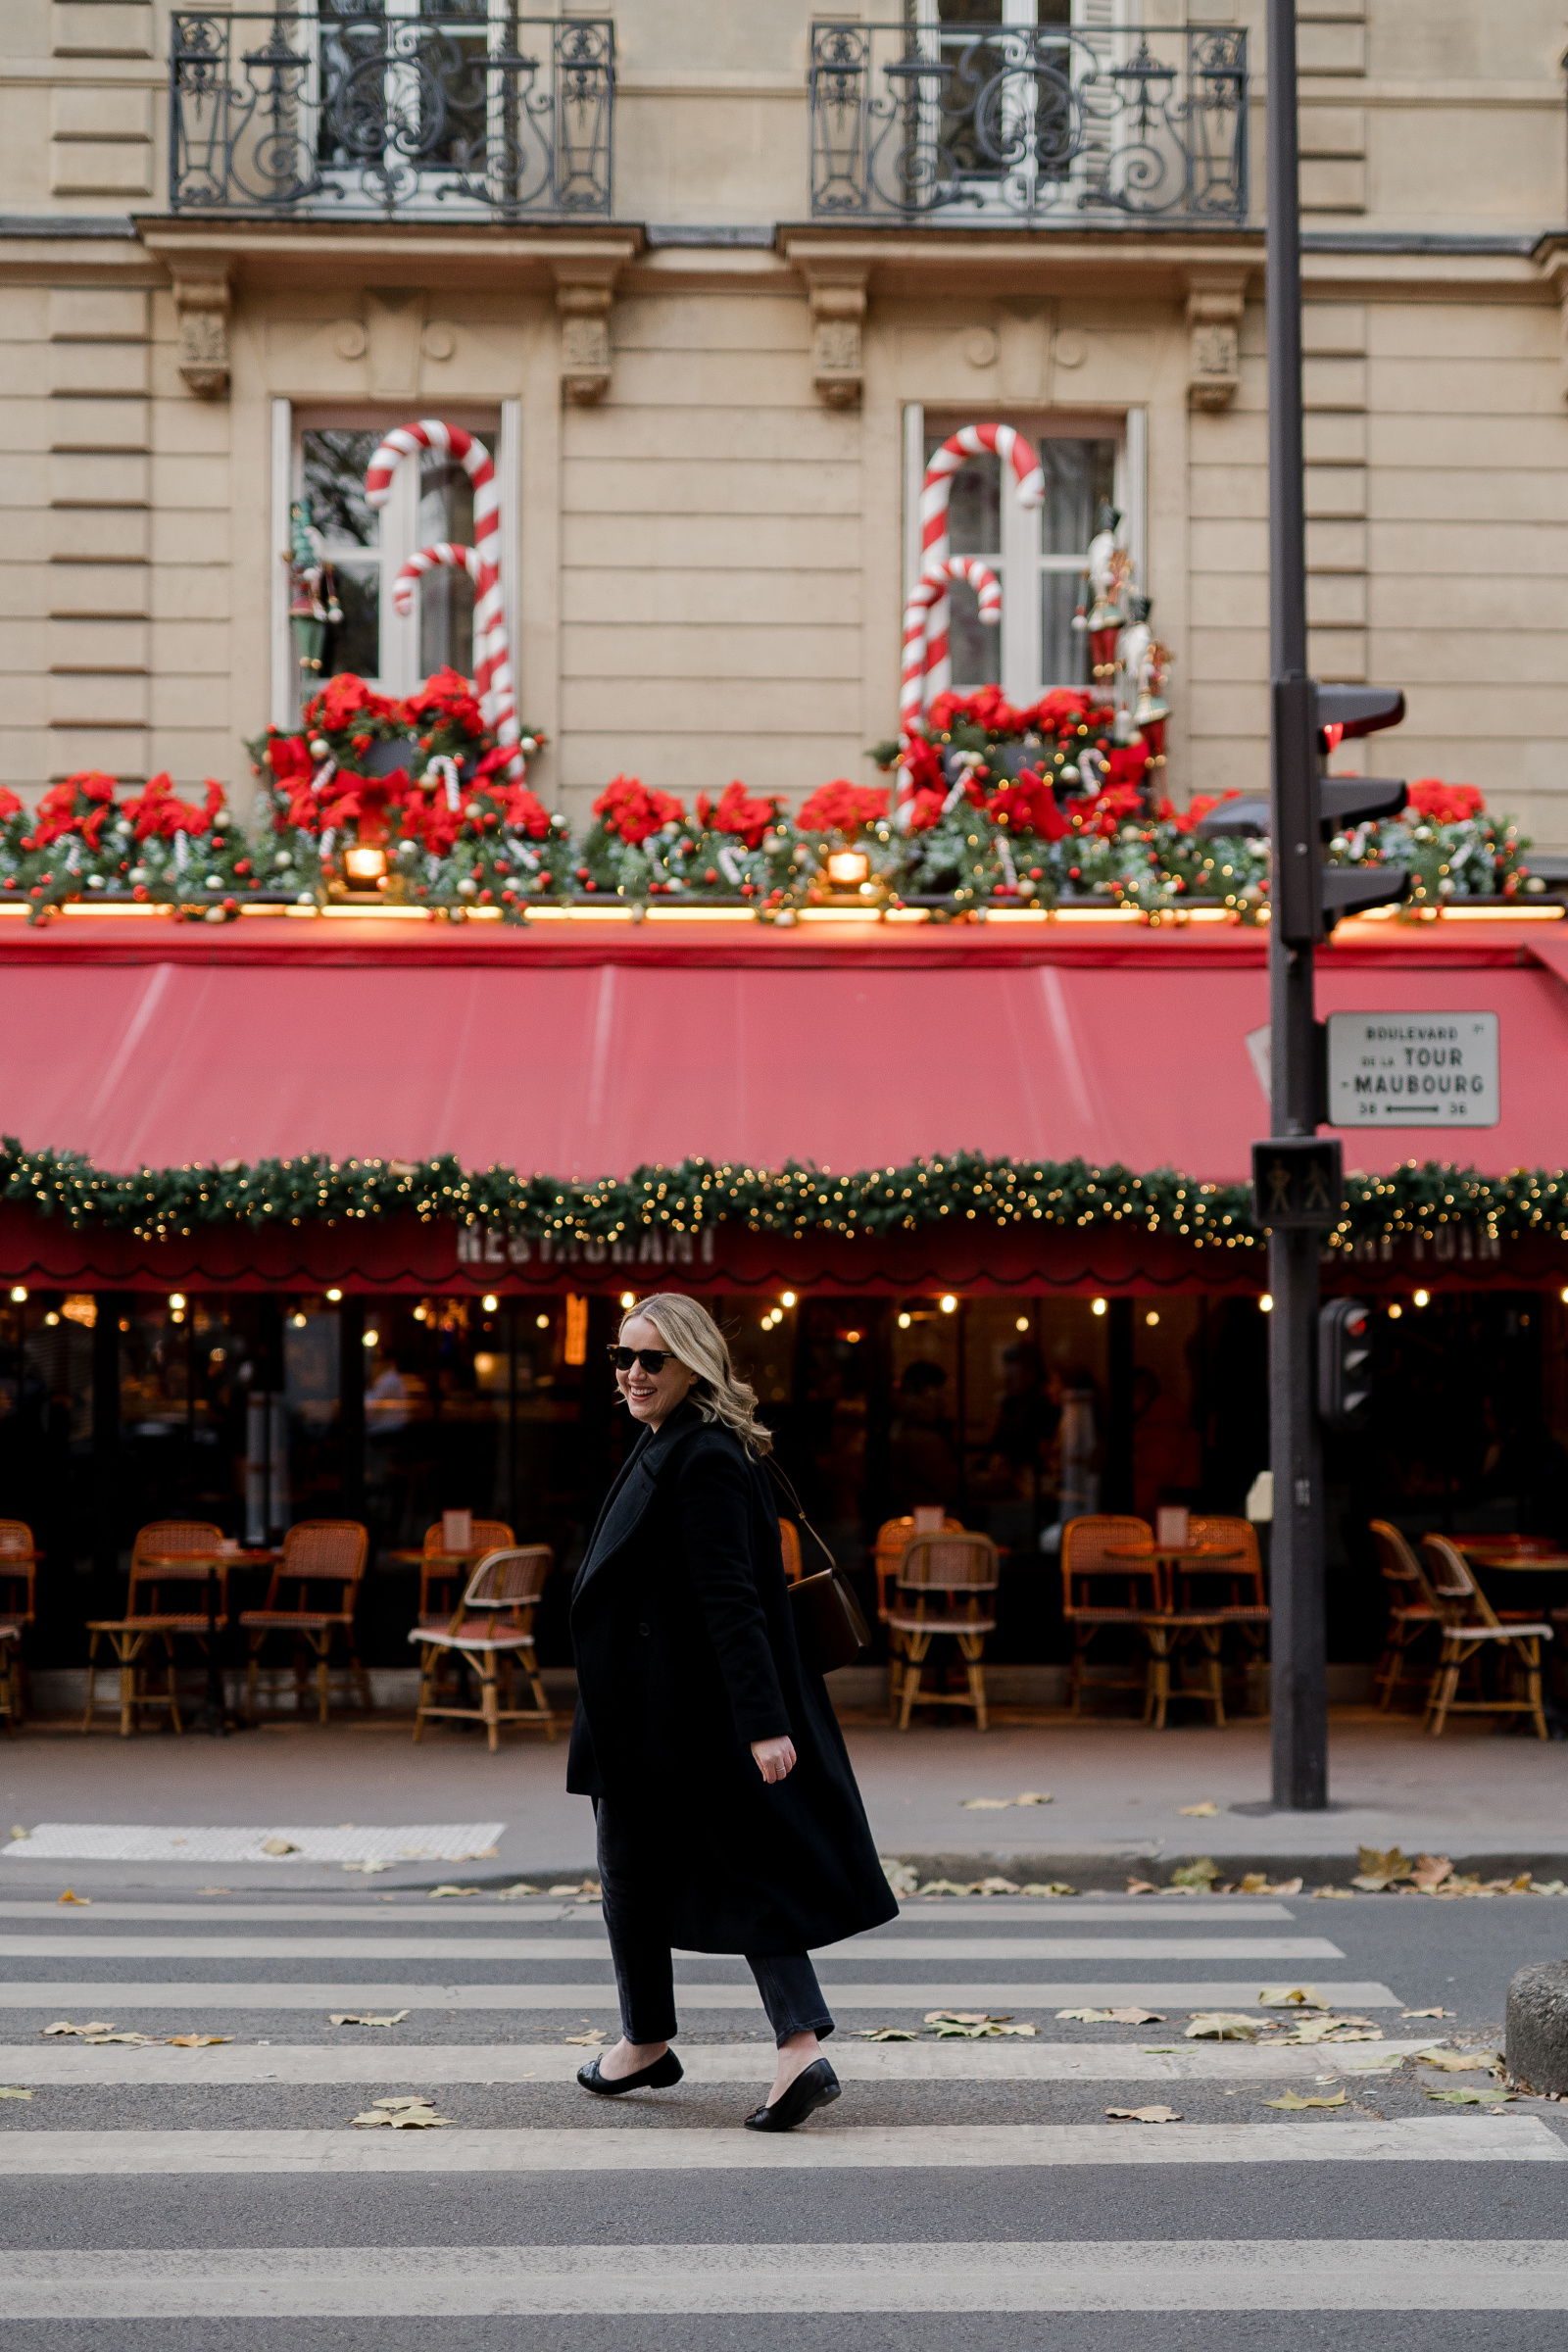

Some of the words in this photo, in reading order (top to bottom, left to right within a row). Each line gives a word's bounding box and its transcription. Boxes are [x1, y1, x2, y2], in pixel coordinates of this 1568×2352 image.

[1366, 1026, 1458, 1041] BOULEVARD
[1361, 1055, 1376, 1067] DE
[1381, 1055, 1395, 1067] LA
[1403, 1047, 1463, 1067] TOUR
